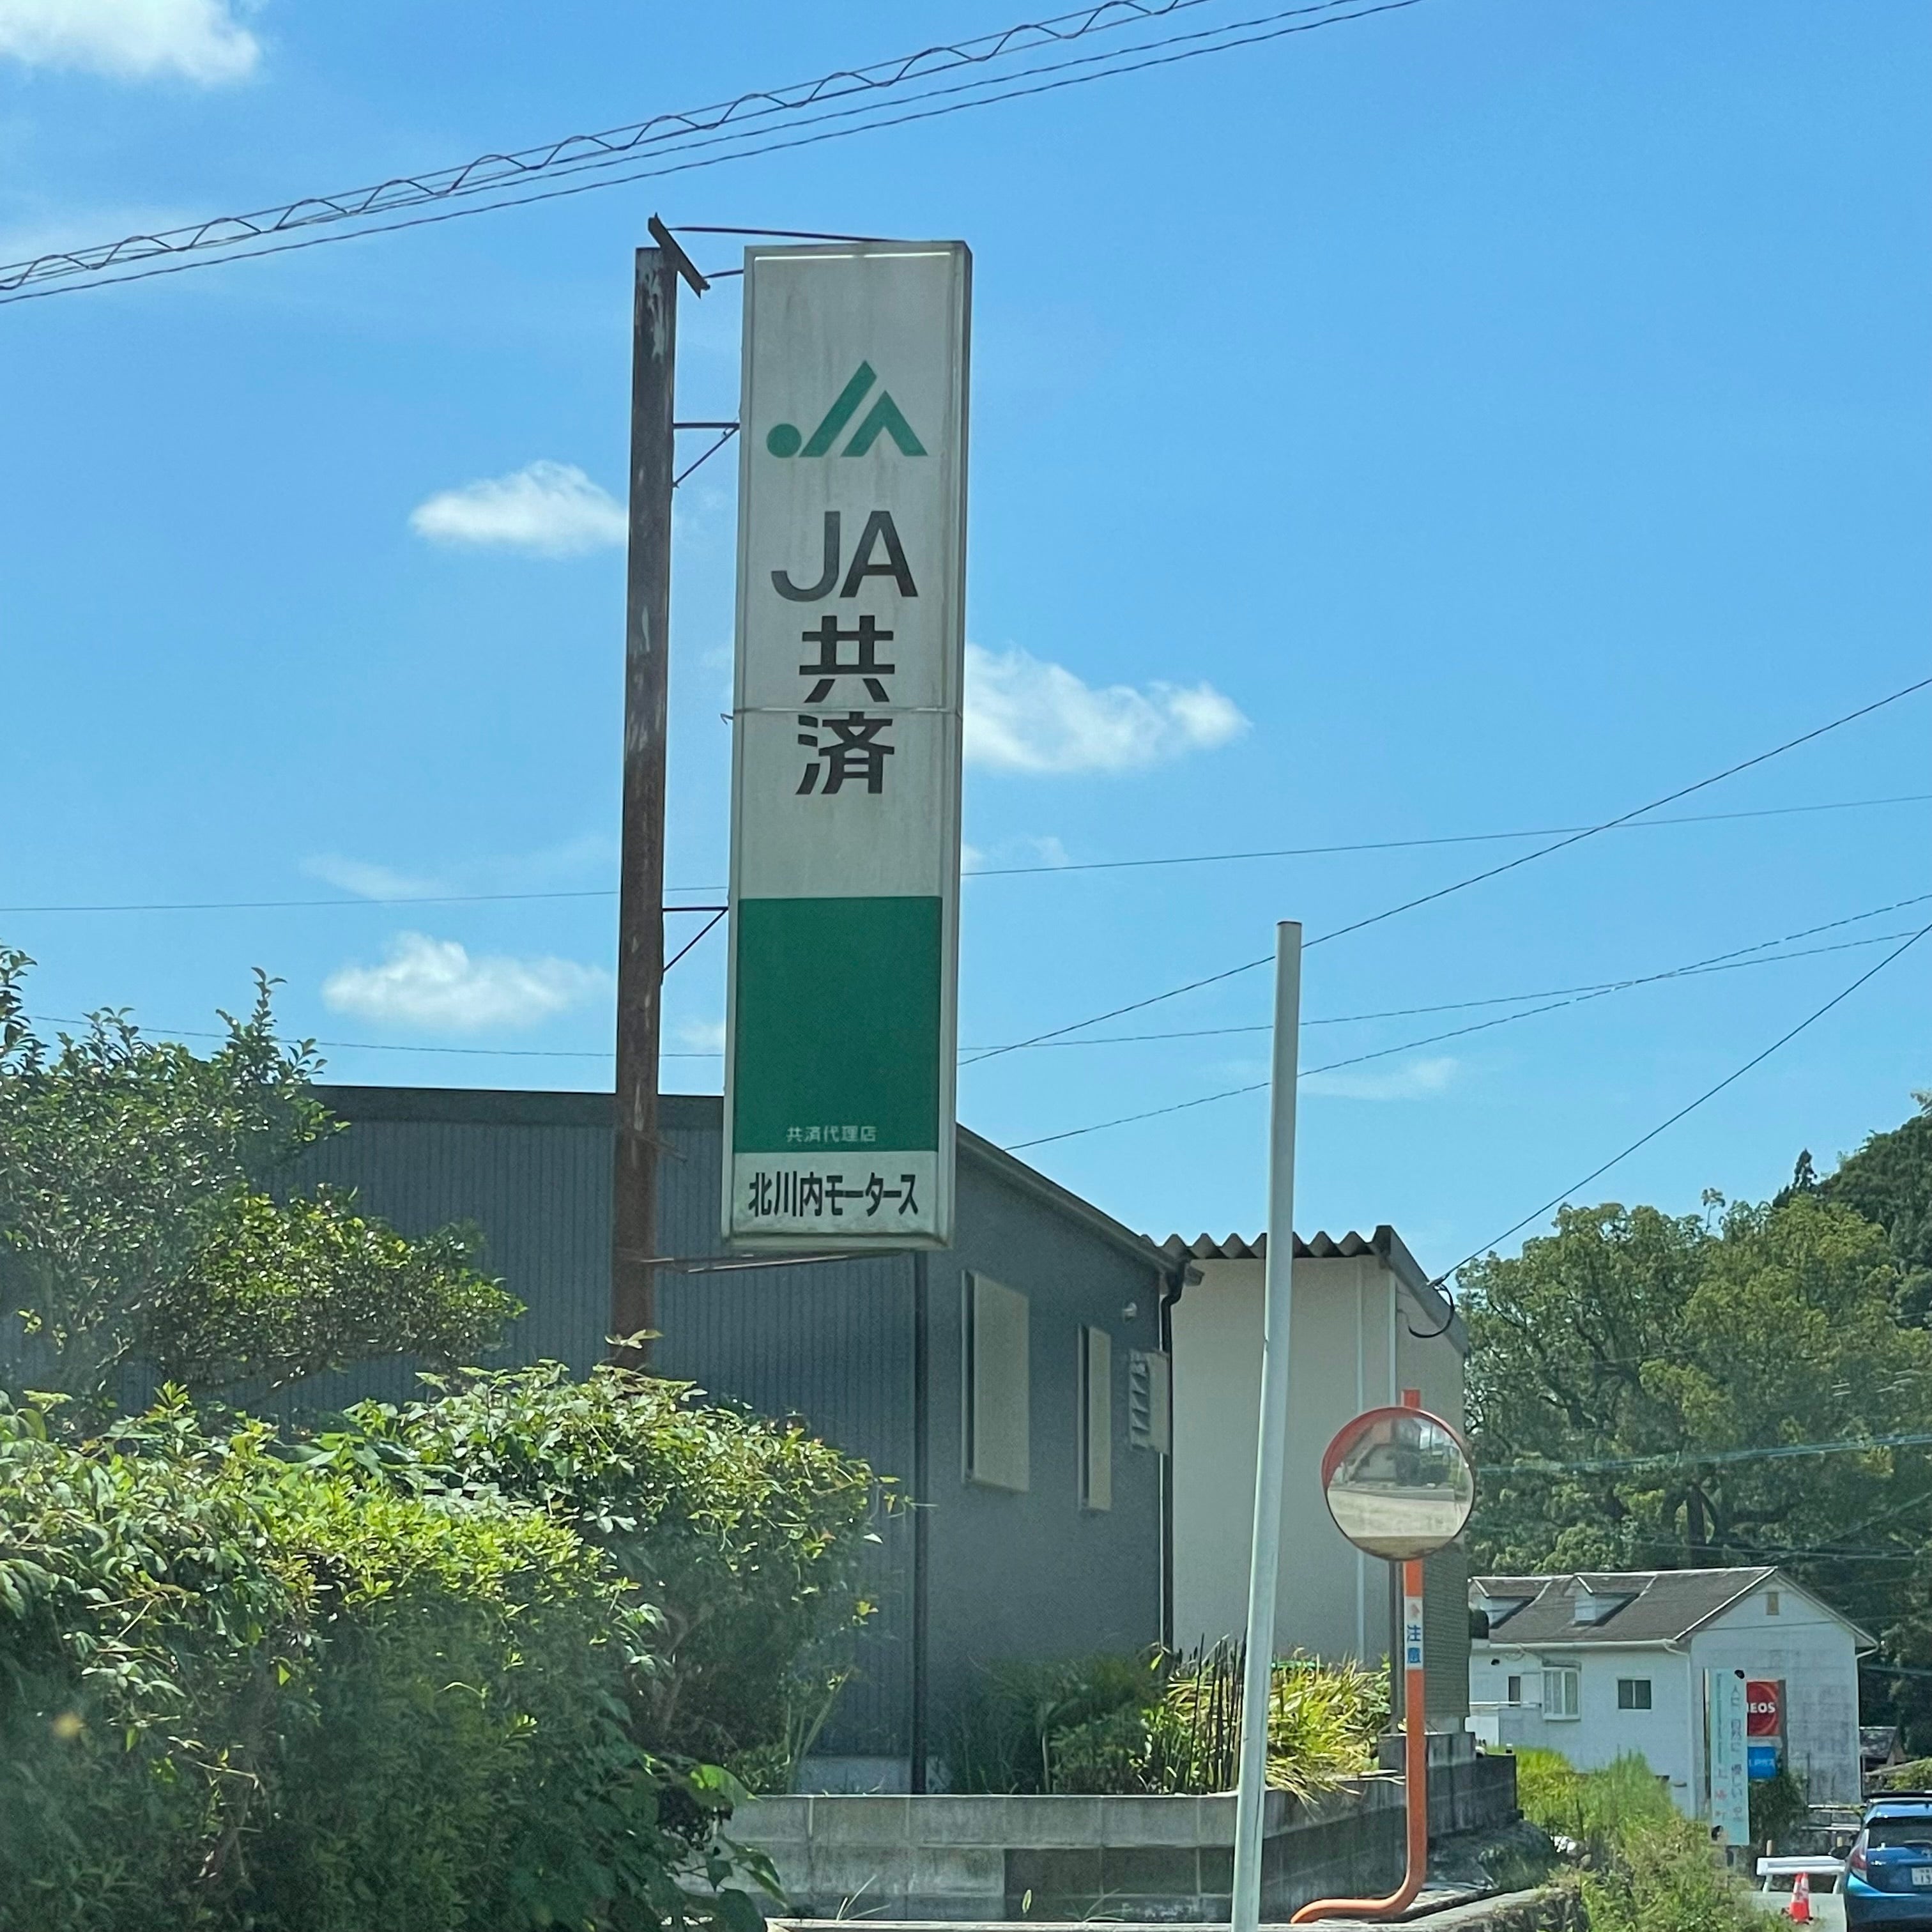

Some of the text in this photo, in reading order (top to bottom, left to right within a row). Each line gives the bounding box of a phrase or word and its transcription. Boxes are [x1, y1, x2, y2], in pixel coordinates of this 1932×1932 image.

[771, 510, 919, 602] JA
[795, 615, 896, 795] 共済
[786, 1125, 877, 1143] 共済代理店
[748, 1170, 919, 1217] 北川内モータース
[1407, 1625, 1421, 1664] 注意
